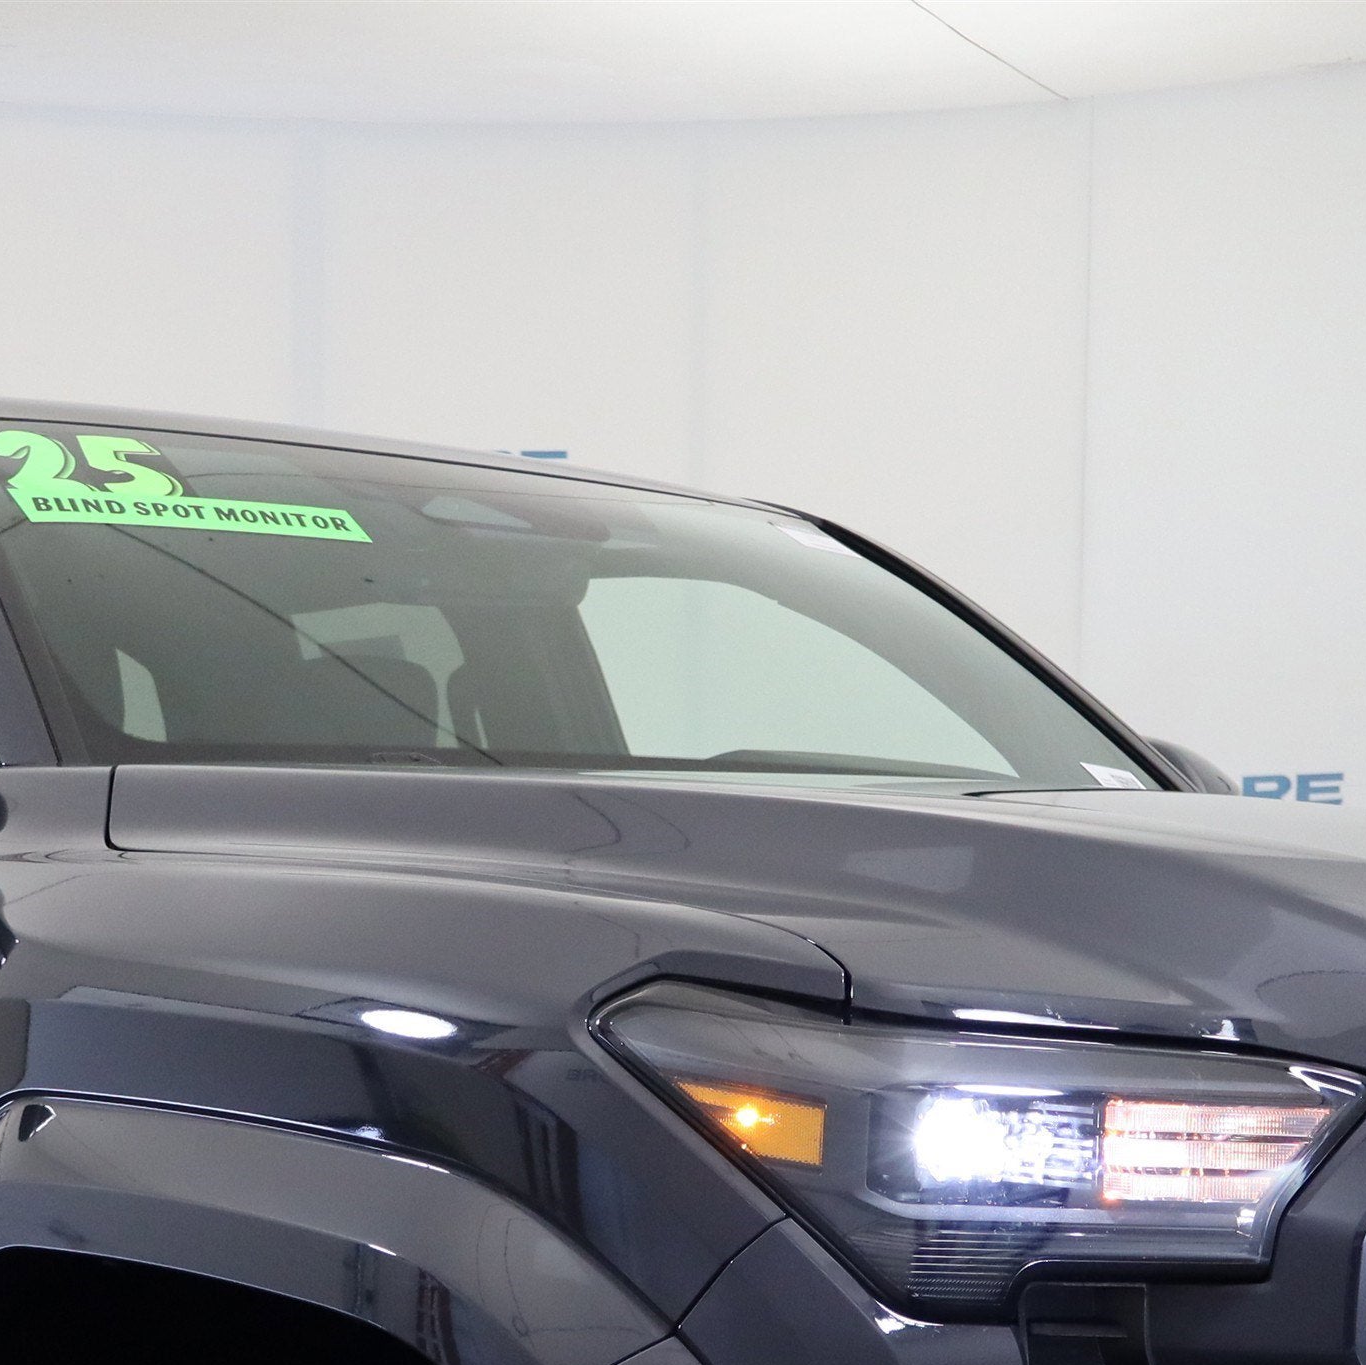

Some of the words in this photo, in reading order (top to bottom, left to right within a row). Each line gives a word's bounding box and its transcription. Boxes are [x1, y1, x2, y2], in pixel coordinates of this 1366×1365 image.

[31, 496, 126, 515] BLIND
[132, 500, 205, 520] SPOT
[213, 506, 352, 532] MONITOR
